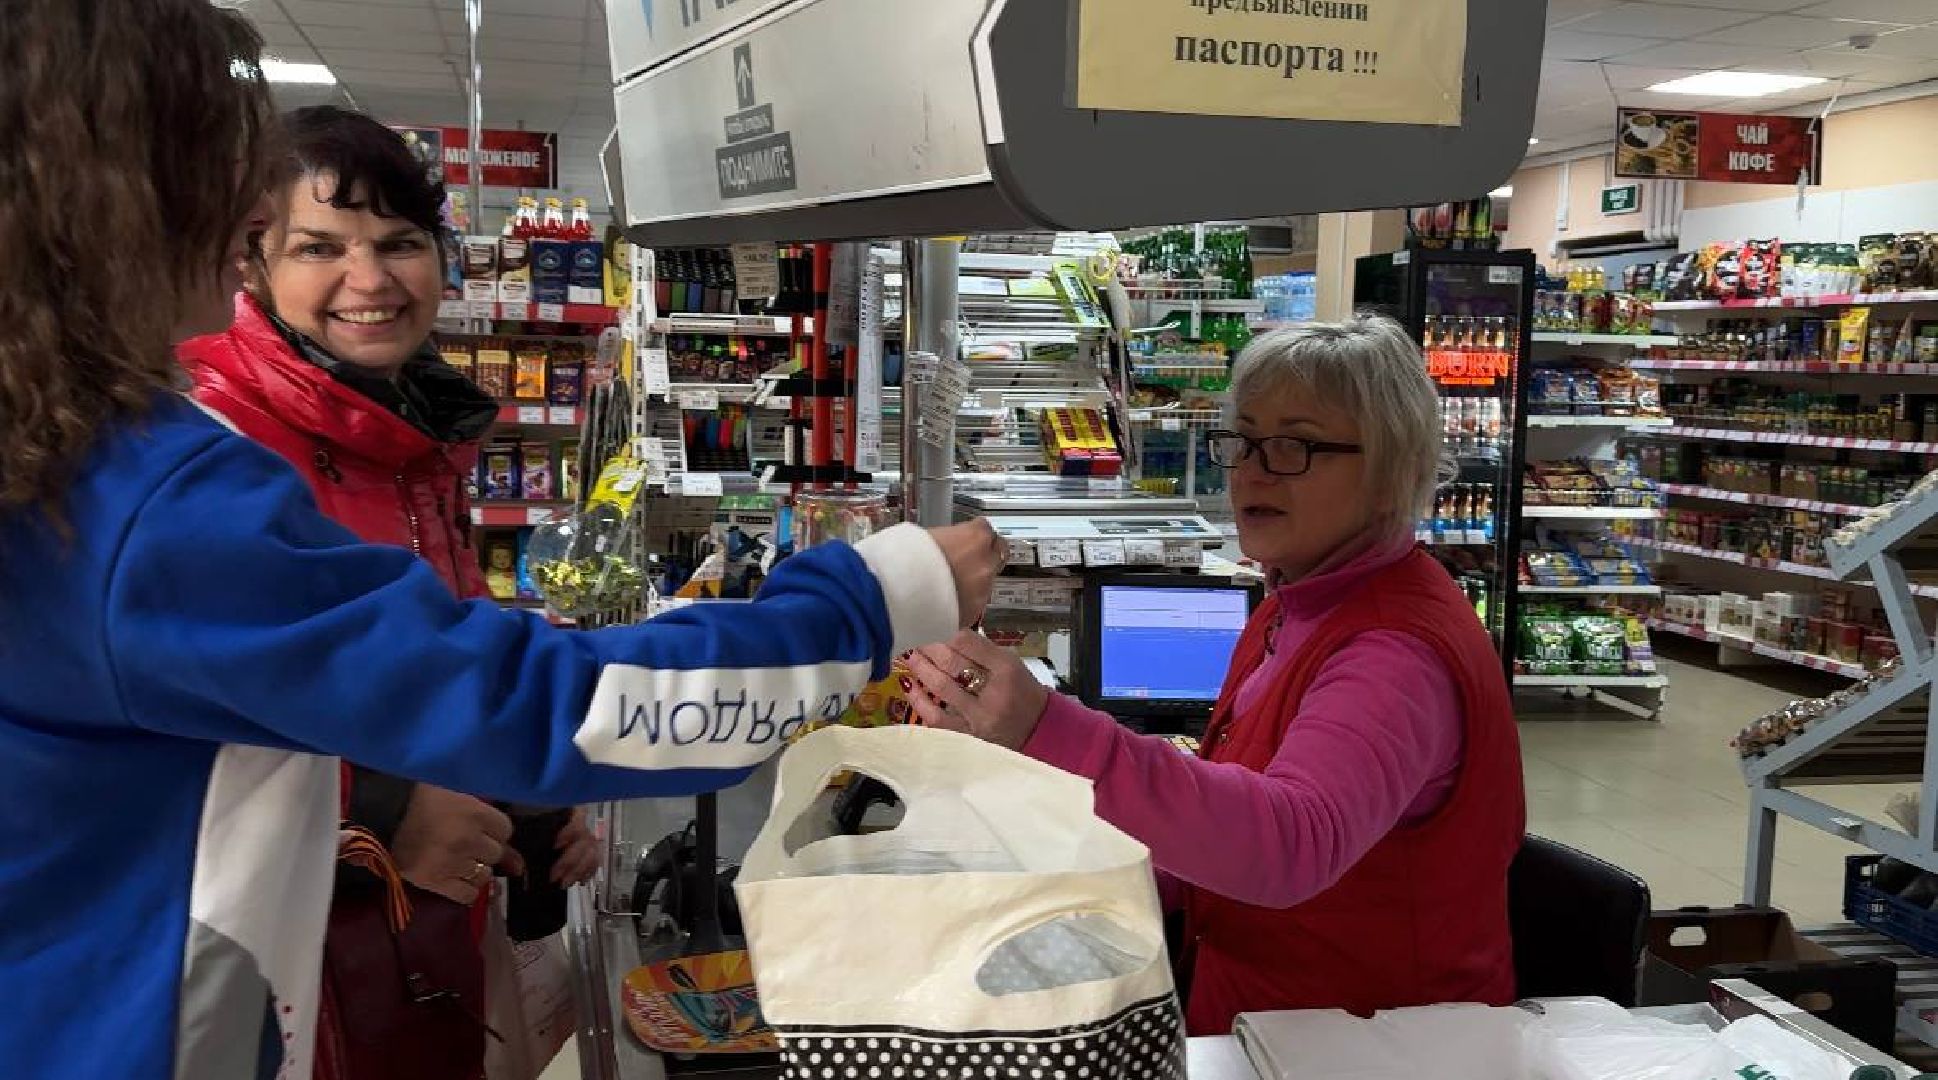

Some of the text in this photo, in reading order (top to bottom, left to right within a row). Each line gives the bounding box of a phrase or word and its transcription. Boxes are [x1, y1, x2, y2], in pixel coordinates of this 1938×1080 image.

[1175, 36, 1378, 78] паспорта !!!
[1736, 122, 1768, 145] ЧАЙ
[445, 147, 540, 168] МООЖЕНОЕ
[720, 144, 791, 191] ПОДНИМИТЕ
[1728, 151, 1775, 172] КОФЕ
